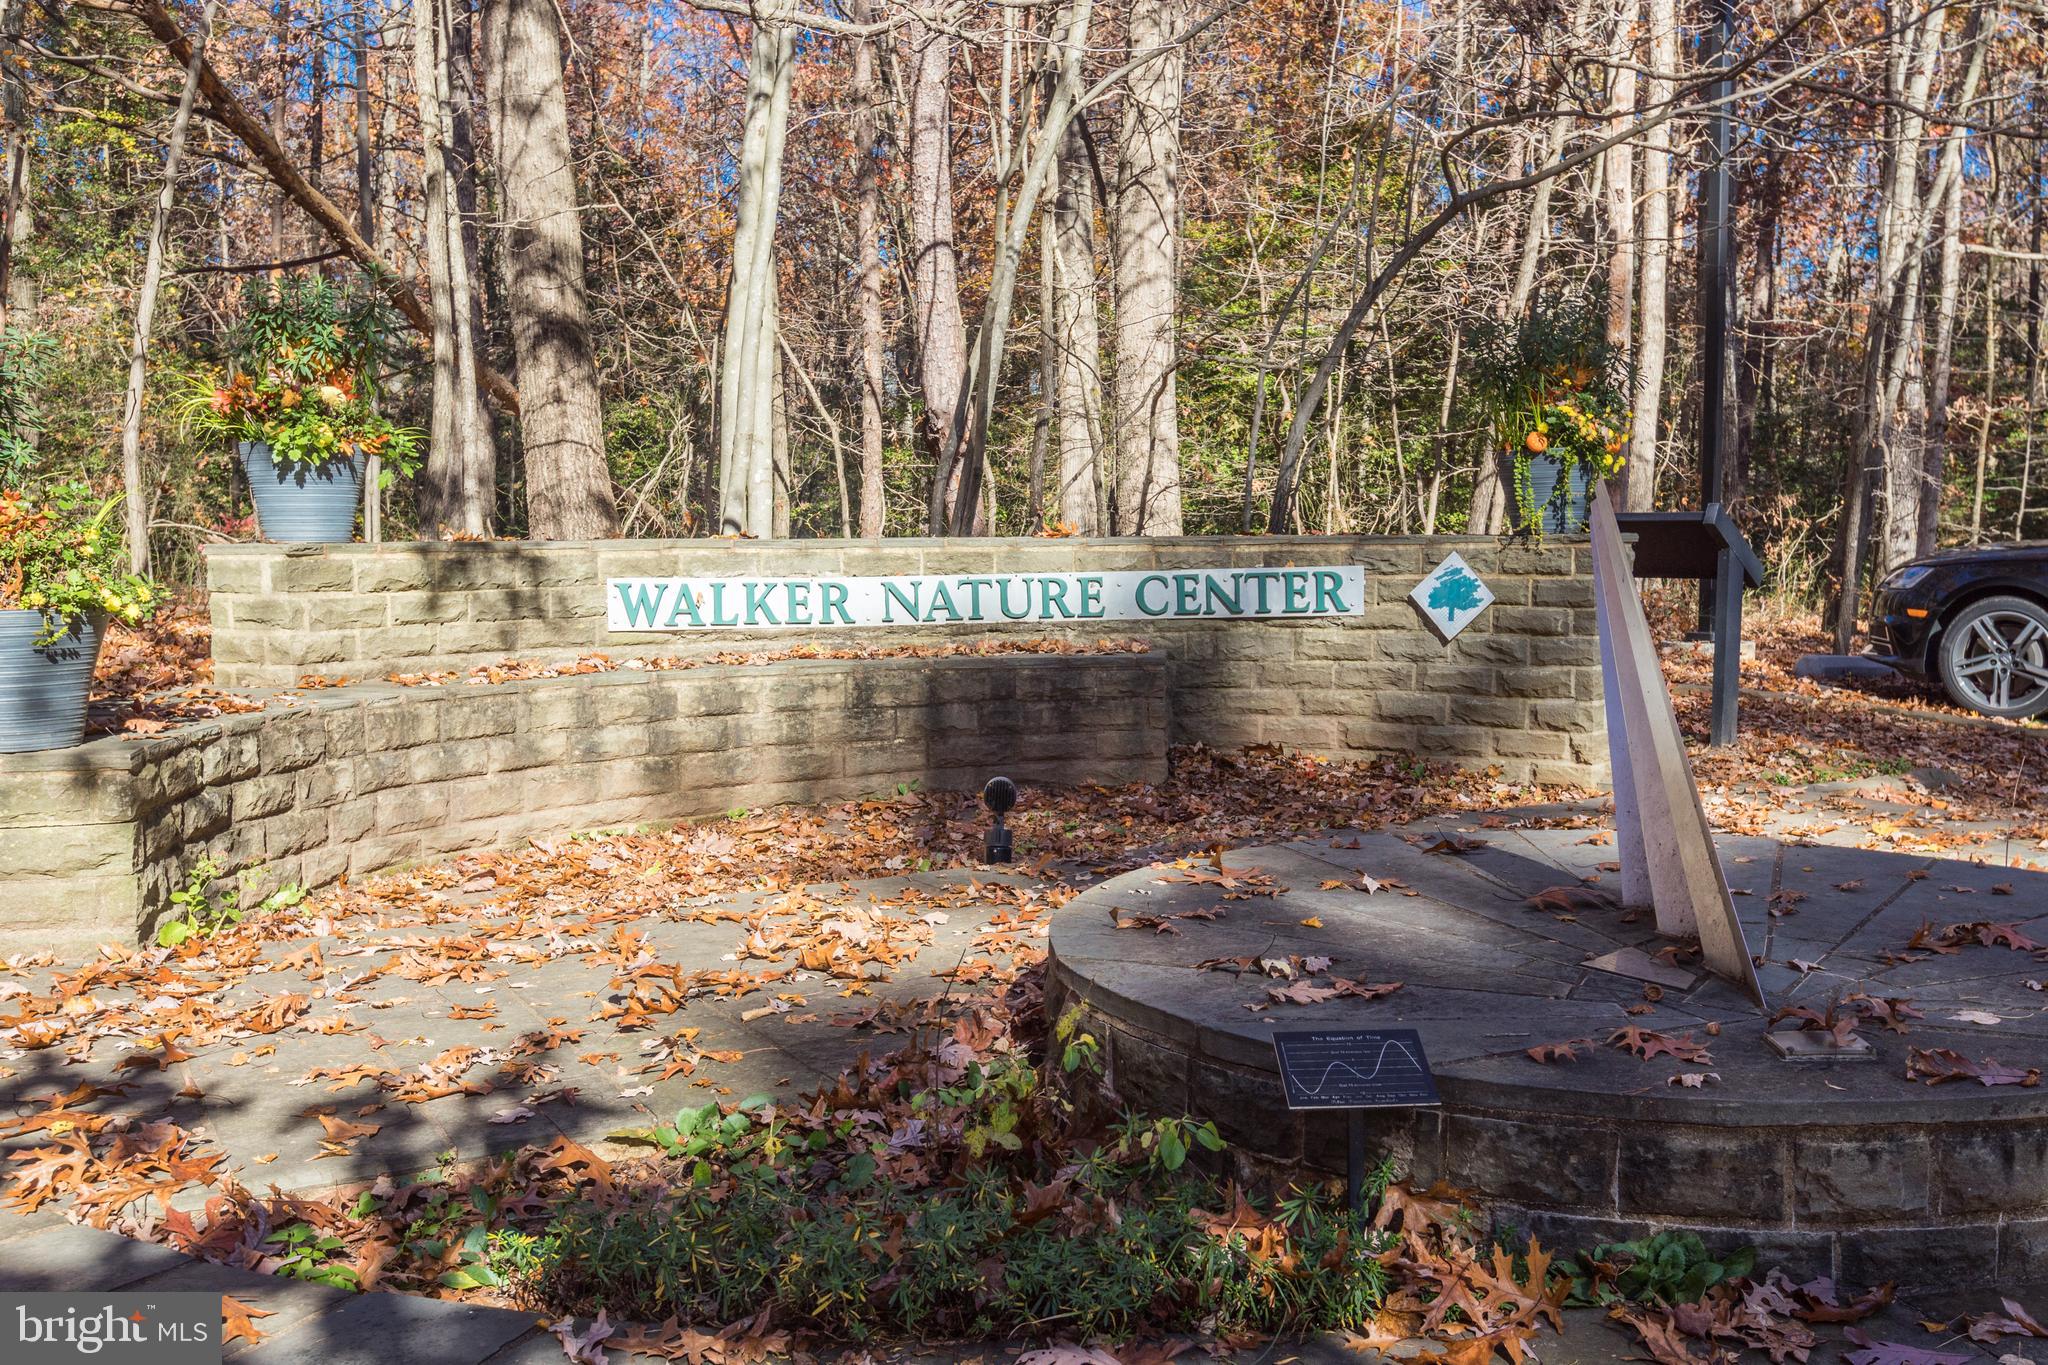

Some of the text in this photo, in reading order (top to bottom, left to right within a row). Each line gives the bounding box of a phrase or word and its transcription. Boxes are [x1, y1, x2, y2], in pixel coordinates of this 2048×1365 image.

[614, 570, 1351, 628] WALKER NATURE CENTER
